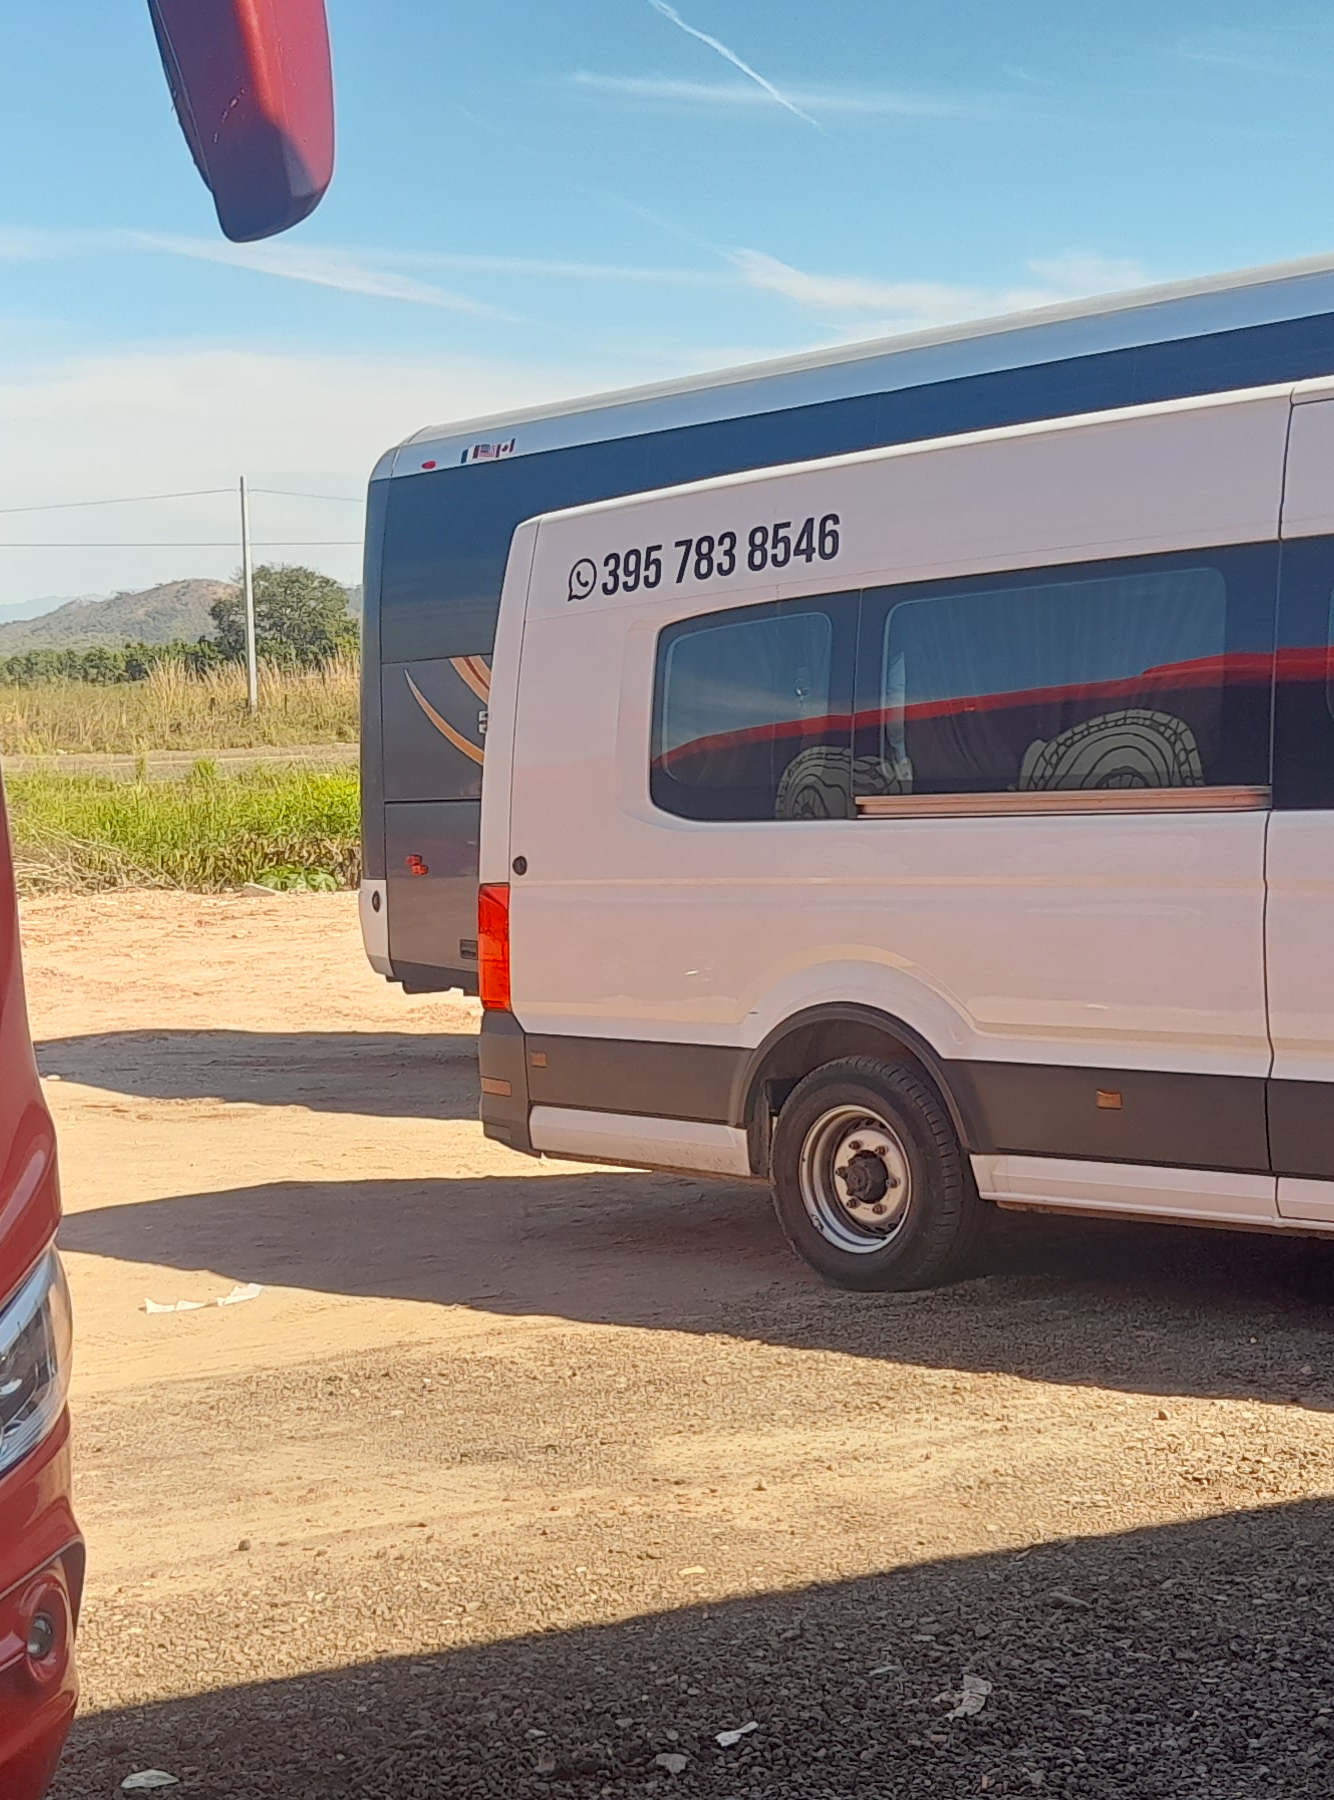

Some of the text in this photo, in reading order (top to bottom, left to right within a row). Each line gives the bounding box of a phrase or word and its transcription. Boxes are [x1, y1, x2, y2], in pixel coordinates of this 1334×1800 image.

[600, 513, 842, 597] 395 783 8546
